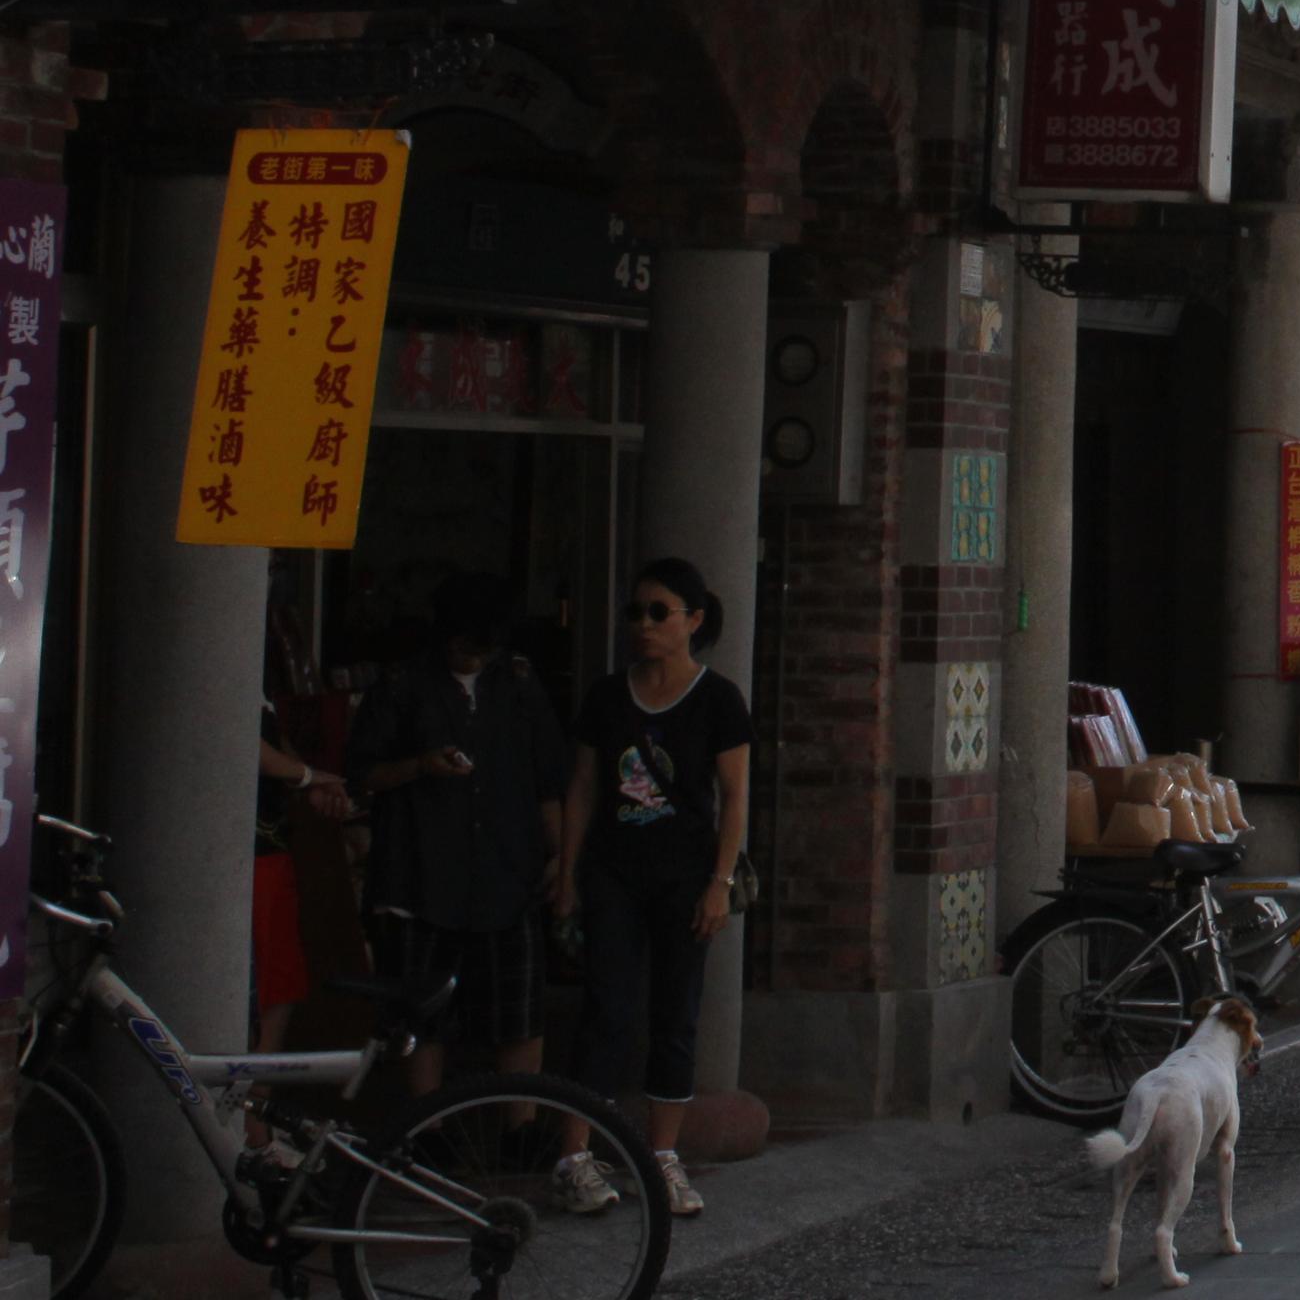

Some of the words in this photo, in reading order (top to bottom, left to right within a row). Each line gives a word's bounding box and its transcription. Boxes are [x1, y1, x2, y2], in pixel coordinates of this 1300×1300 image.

[258, 156, 377, 183] 老街第一味
[614, 252, 651, 292] 45
[0, 296, 39, 345] 製
[302, 199, 378, 528] 國家乙級廚師
